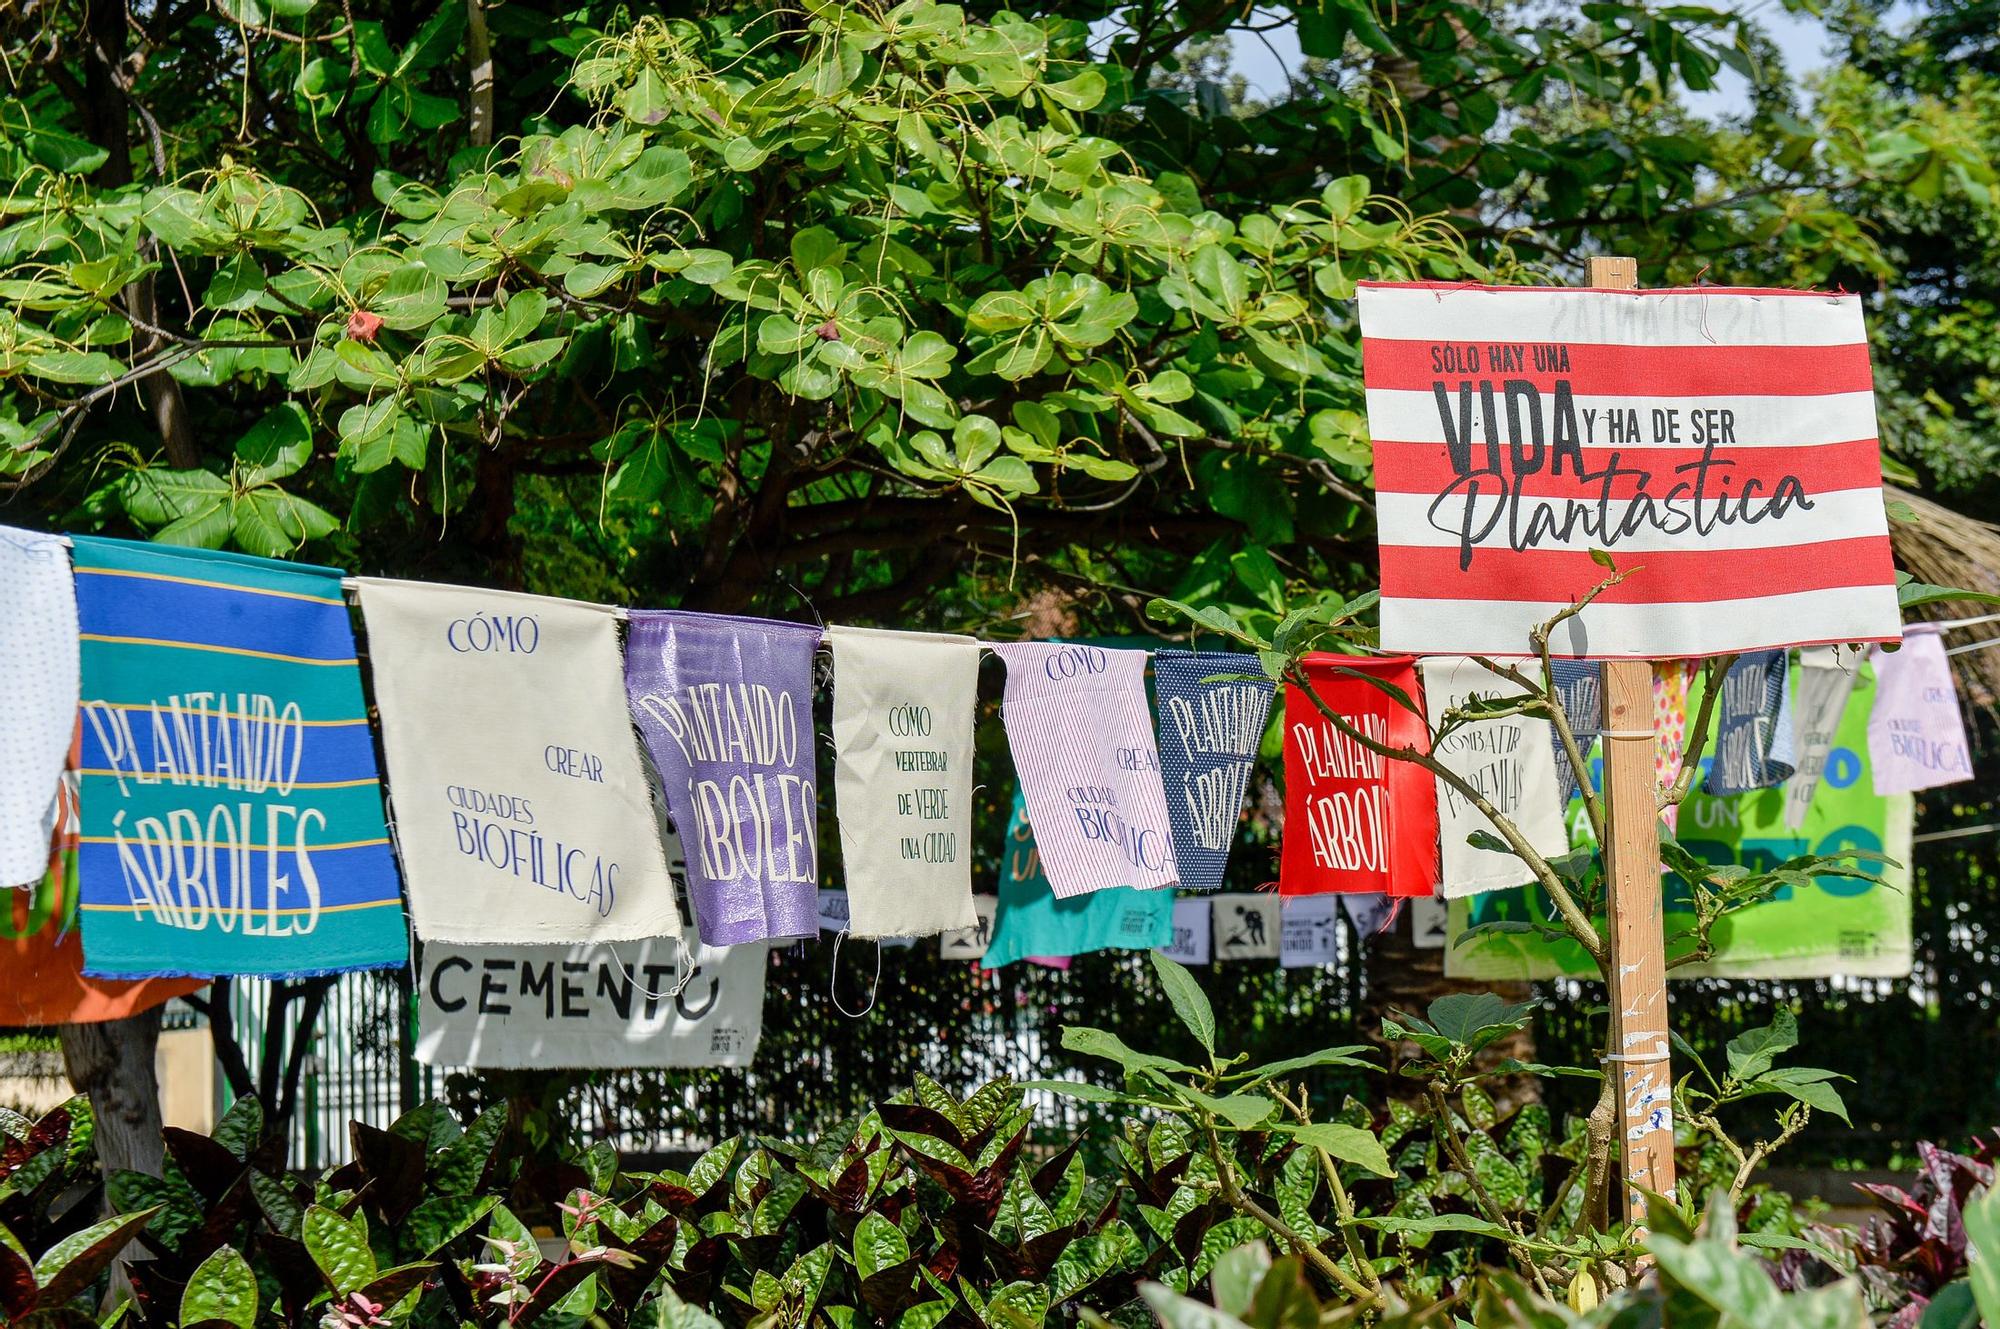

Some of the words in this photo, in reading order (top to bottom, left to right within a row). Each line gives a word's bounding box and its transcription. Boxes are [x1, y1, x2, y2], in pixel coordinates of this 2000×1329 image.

[1488, 345, 1524, 372] HAY
[1533, 345, 1571, 372] UNA
[1432, 379, 1585, 476] VIDA
[1582, 408, 1596, 443] Y
[1608, 408, 1641, 443] HA
[1652, 409, 1681, 443] DE
[1691, 409, 1736, 444] SER
[1427, 443, 1814, 572] Plantástica
[447, 611, 540, 654] CÓMO
[1046, 646, 1106, 681] CÓMO
[889, 702, 931, 737] CÓMO
[1168, 686, 1268, 763] PLANTANDO
[85, 691, 304, 798] PLANTANDO
[1439, 725, 1521, 755] COMBATIR
[545, 745, 604, 784] CREAR
[895, 751, 948, 772] VERTEBRAR
[447, 785, 534, 825] CIUDADES
[898, 793, 912, 815] DE
[915, 788, 949, 819] VERDE
[1694, 799, 1740, 829] UN
[452, 811, 620, 917] BIOFÍLICAS
[901, 837, 920, 860] UNA
[924, 832, 956, 863] CIUDAD
[112, 802, 326, 937] ÁRBOLES
[429, 955, 719, 1021] CEMENTO
